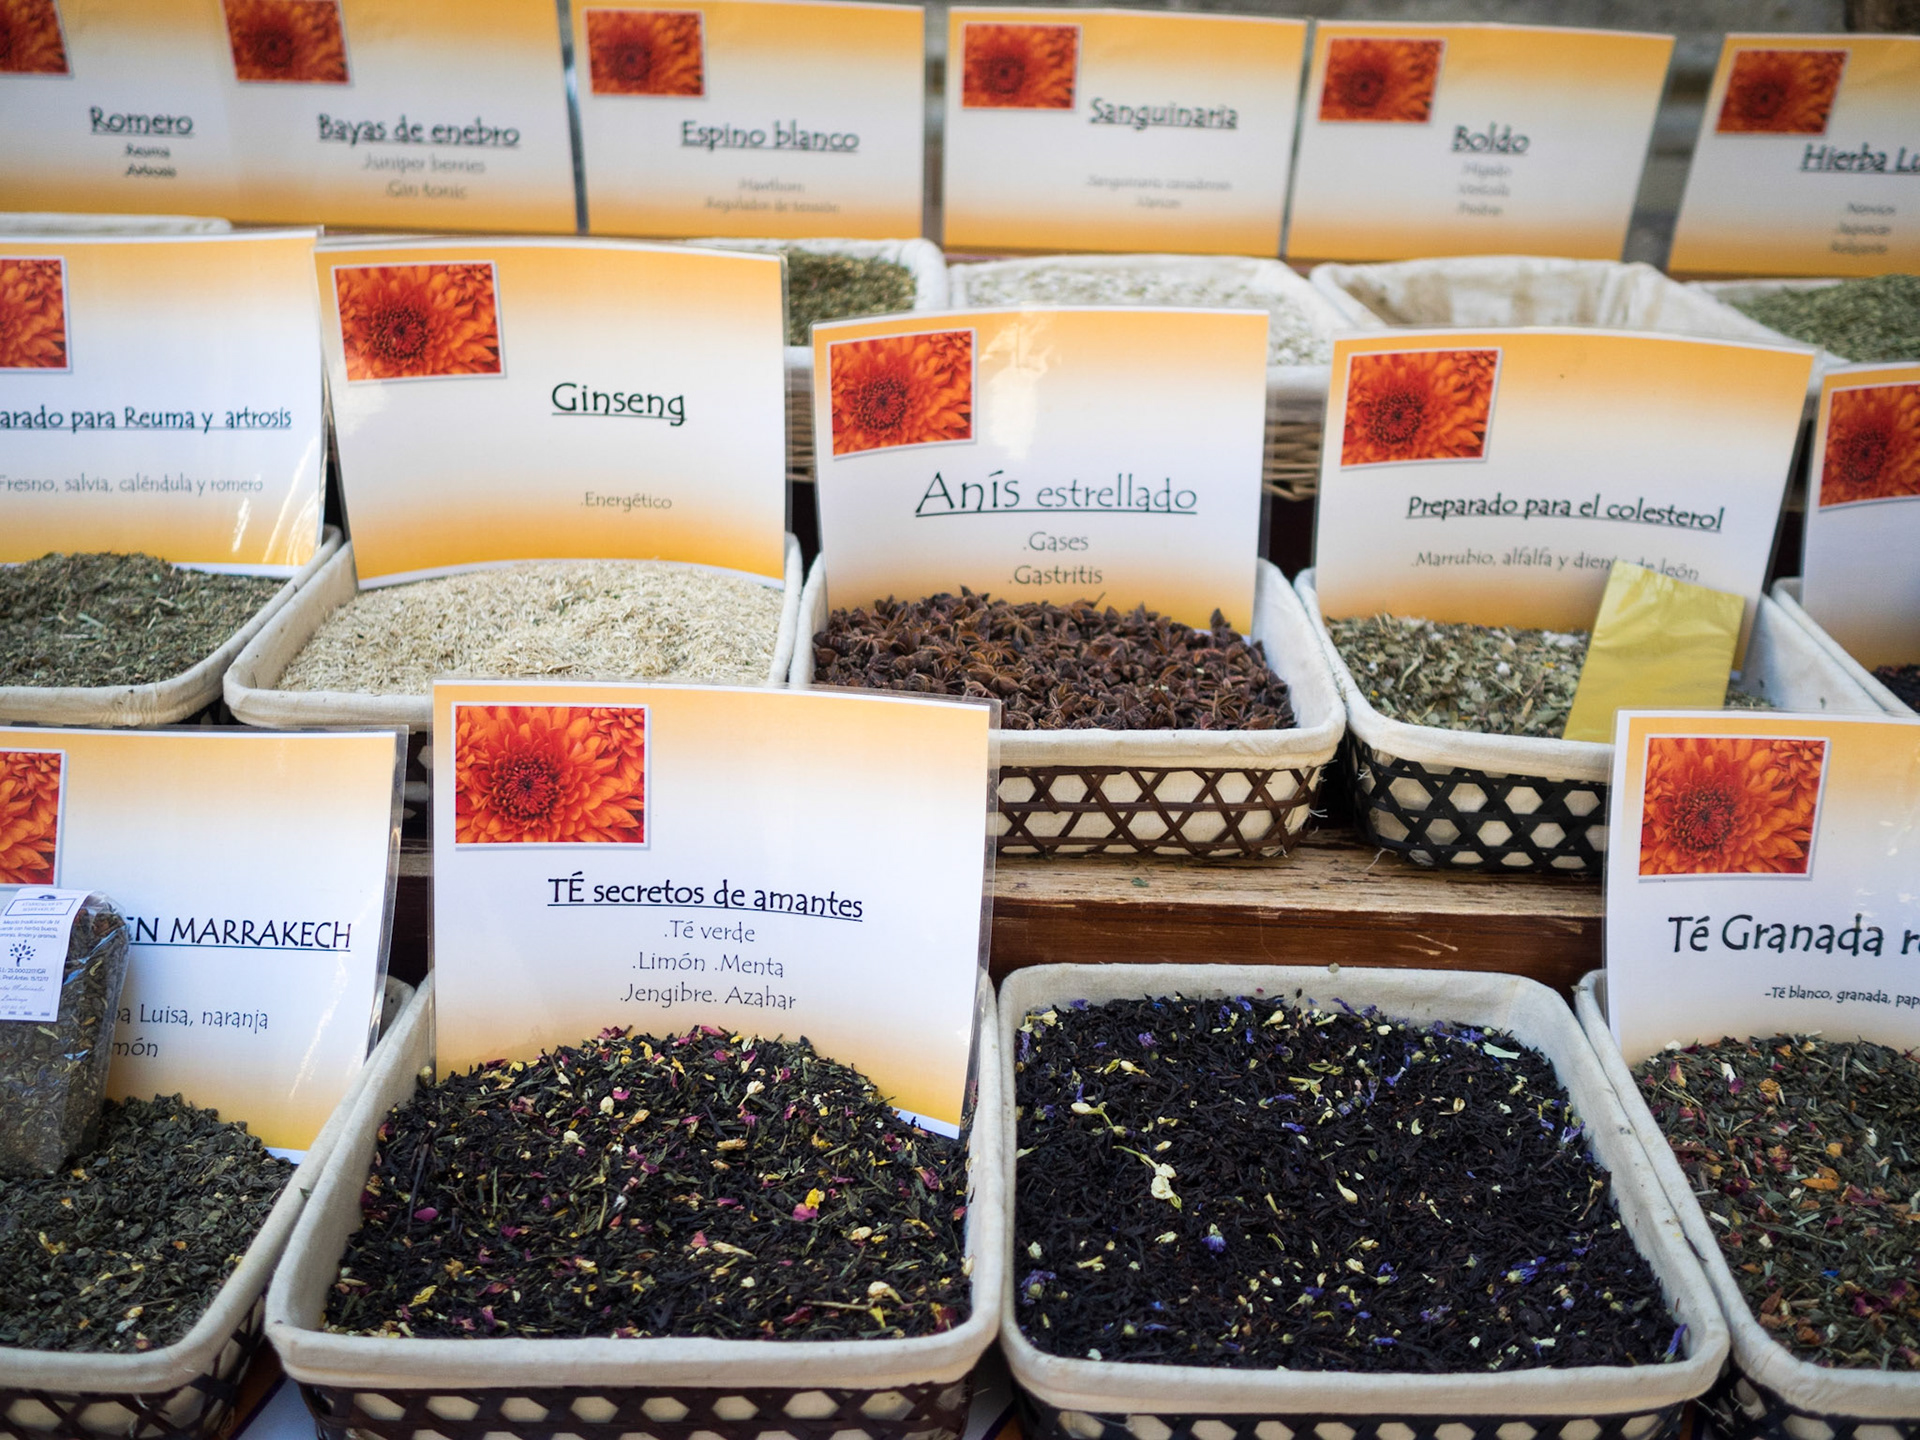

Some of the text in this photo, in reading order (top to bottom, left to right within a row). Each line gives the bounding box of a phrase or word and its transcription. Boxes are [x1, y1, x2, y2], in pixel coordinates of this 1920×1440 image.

[90, 105, 193, 136] Romero
[318, 112, 520, 147] Bayas de enebro
[1089, 96, 1238, 131] Sanguinaria
[681, 118, 860, 152] Espino blanco
[1453, 120, 1530, 154] Boldo
[1802, 142, 1887, 172] Hierba
[72, 410, 115, 434] para
[125, 406, 195, 429] Reuma
[202, 411, 213, 433] y
[226, 406, 292, 429] artrosis
[551, 382, 686, 427] Ginseng
[65, 472, 113, 493] salvia,
[119, 472, 192, 492] caléndula
[197, 479, 206, 496] y
[211, 478, 263, 492] romero
[915, 469, 1198, 514] Anís estrellado
[1407, 491, 1725, 532] Preparado para el colesterol
[1023, 530, 1089, 552] .Gases
[1008, 564, 1103, 586] .Gastritis
[1502, 546, 1552, 569] alfalfa
[1557, 556, 1568, 571] y
[1573, 551, 1622, 571] dien
[1660, 557, 1700, 581] león
[547, 871, 863, 918] TÉ secretos de amantes
[127, 916, 352, 949] N MARRAKECH
[664, 919, 756, 944] .Té verde
[1668, 912, 1920, 957] Té Granada r
[632, 951, 785, 978] .Limón .Menta
[620, 981, 796, 1010] .Jengibre. Azahar
[1764, 984, 1920, 1010] -Té blanco, granada, pap
[139, 1003, 194, 1026] Luisa,
[202, 1008, 269, 1034] naranja
